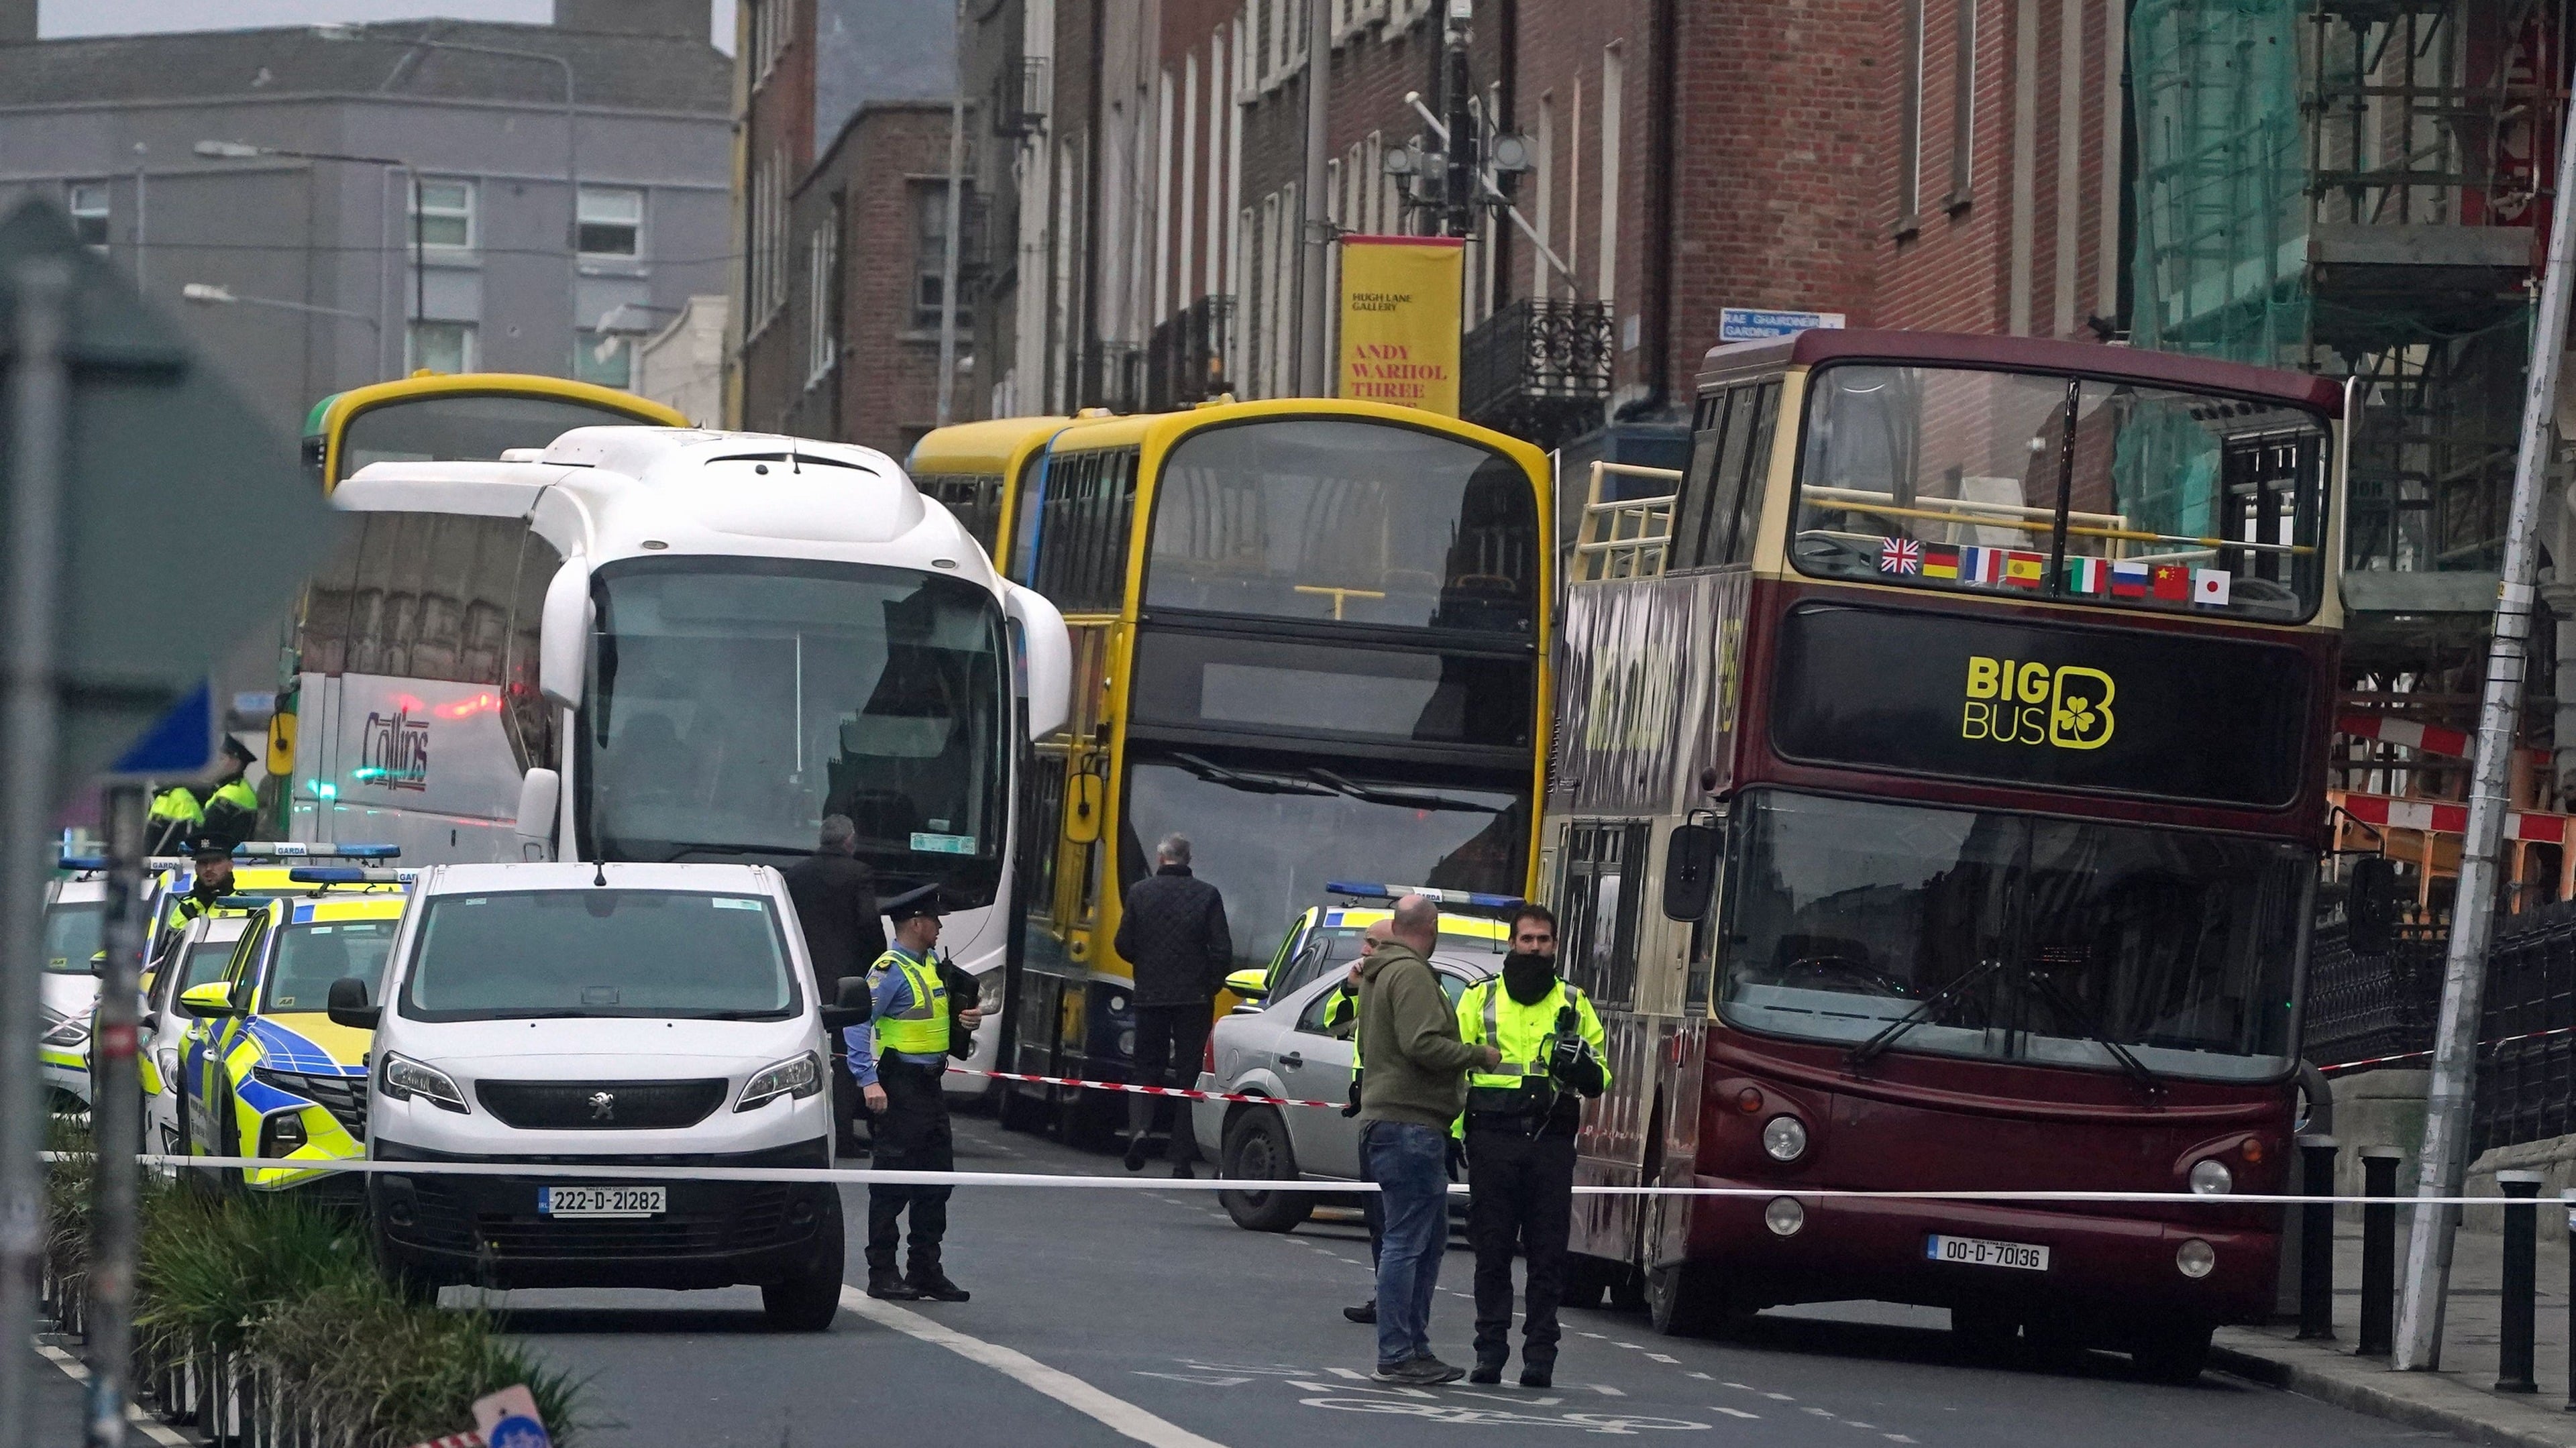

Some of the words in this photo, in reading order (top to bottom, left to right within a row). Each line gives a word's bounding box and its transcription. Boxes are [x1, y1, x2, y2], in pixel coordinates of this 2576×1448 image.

[1352, 292, 1383, 302] HUGH
[1386, 294, 1412, 302] LANE
[1352, 302, 1397, 312] GALLERY
[1351, 344, 1411, 359] ANDY
[1351, 363, 1447, 380] WARHOL
[1351, 382, 1425, 398] THREE
[1966, 656, 2049, 704] BIG
[1963, 701, 2045, 744] BUS
[362, 706, 429, 790] Collins
[555, 1191, 660, 1210] 222-D-21282
[1947, 1241, 2040, 1268] 00-D-70136
